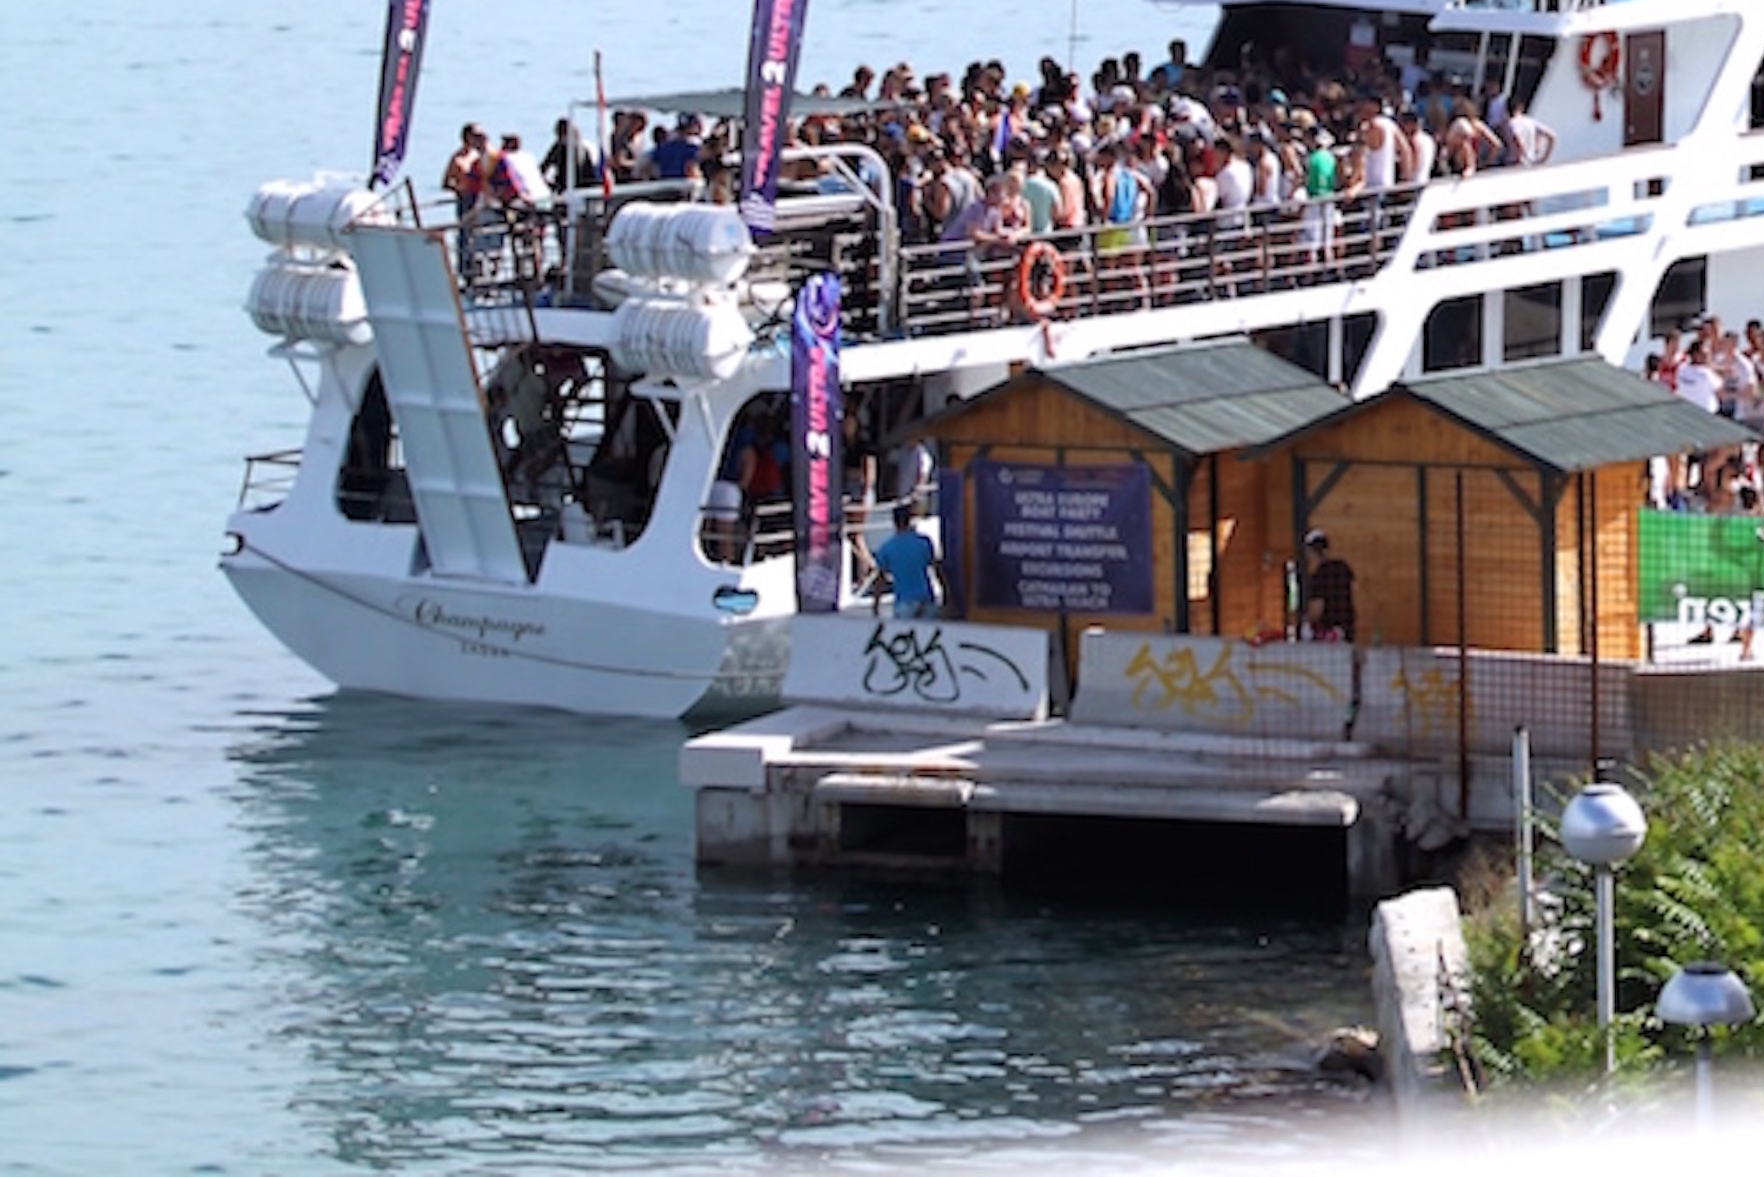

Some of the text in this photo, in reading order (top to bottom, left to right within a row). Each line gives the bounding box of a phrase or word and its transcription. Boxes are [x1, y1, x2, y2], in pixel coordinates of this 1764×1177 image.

[398, 28, 417, 52] 2
[761, 60, 787, 85] 2
[754, 85, 784, 188] TRAVEL
[809, 346, 829, 432] ULTRA
[806, 430, 830, 458] 2
[809, 457, 830, 560] TRAVEL
[397, 597, 546, 641] Champagne
